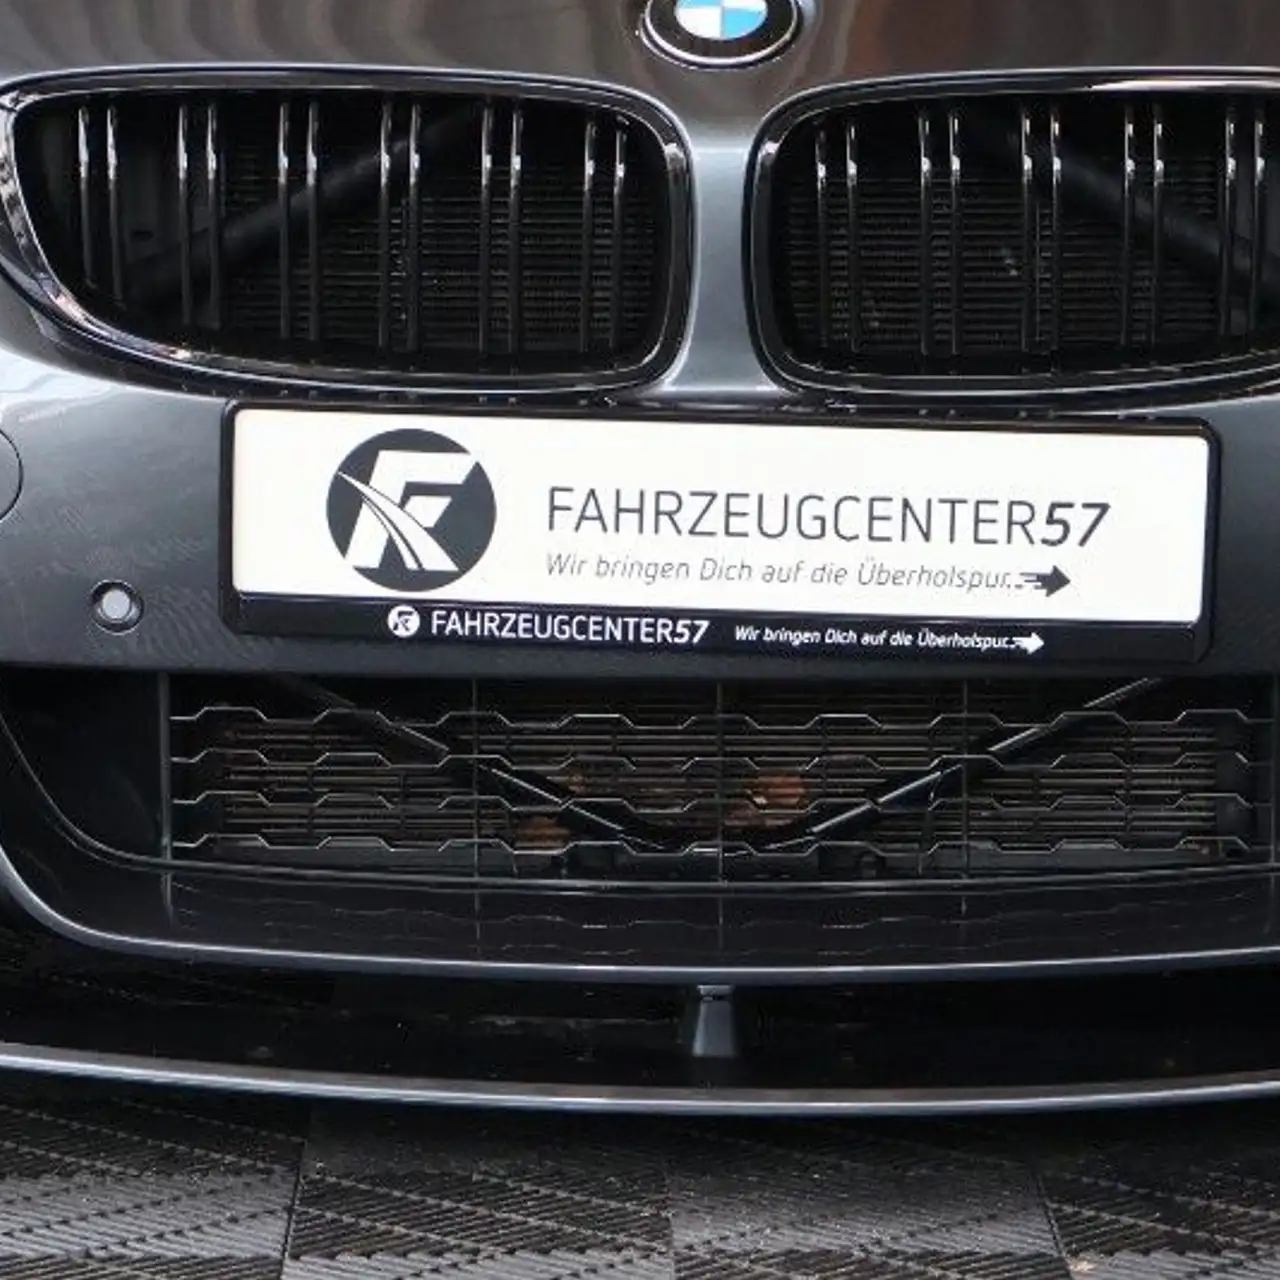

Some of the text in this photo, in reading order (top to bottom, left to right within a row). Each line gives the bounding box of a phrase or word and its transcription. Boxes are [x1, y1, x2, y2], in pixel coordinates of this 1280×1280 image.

[548, 486, 1111, 548] FAHRZEUGCENTER57
[547, 552, 585, 577] Wir
[595, 556, 690, 586] bringen
[699, 557, 753, 583] Dich
[761, 559, 802, 585] auf
[809, 562, 848, 587] die
[431, 610, 710, 644] FAHRZEUGCENTER57
[734, 624, 760, 642] Wir
[763, 627, 820, 646] bringen
[824, 628, 857, 645] Dich
[861, 630, 887, 646] auf
[891, 631, 913, 647] die
